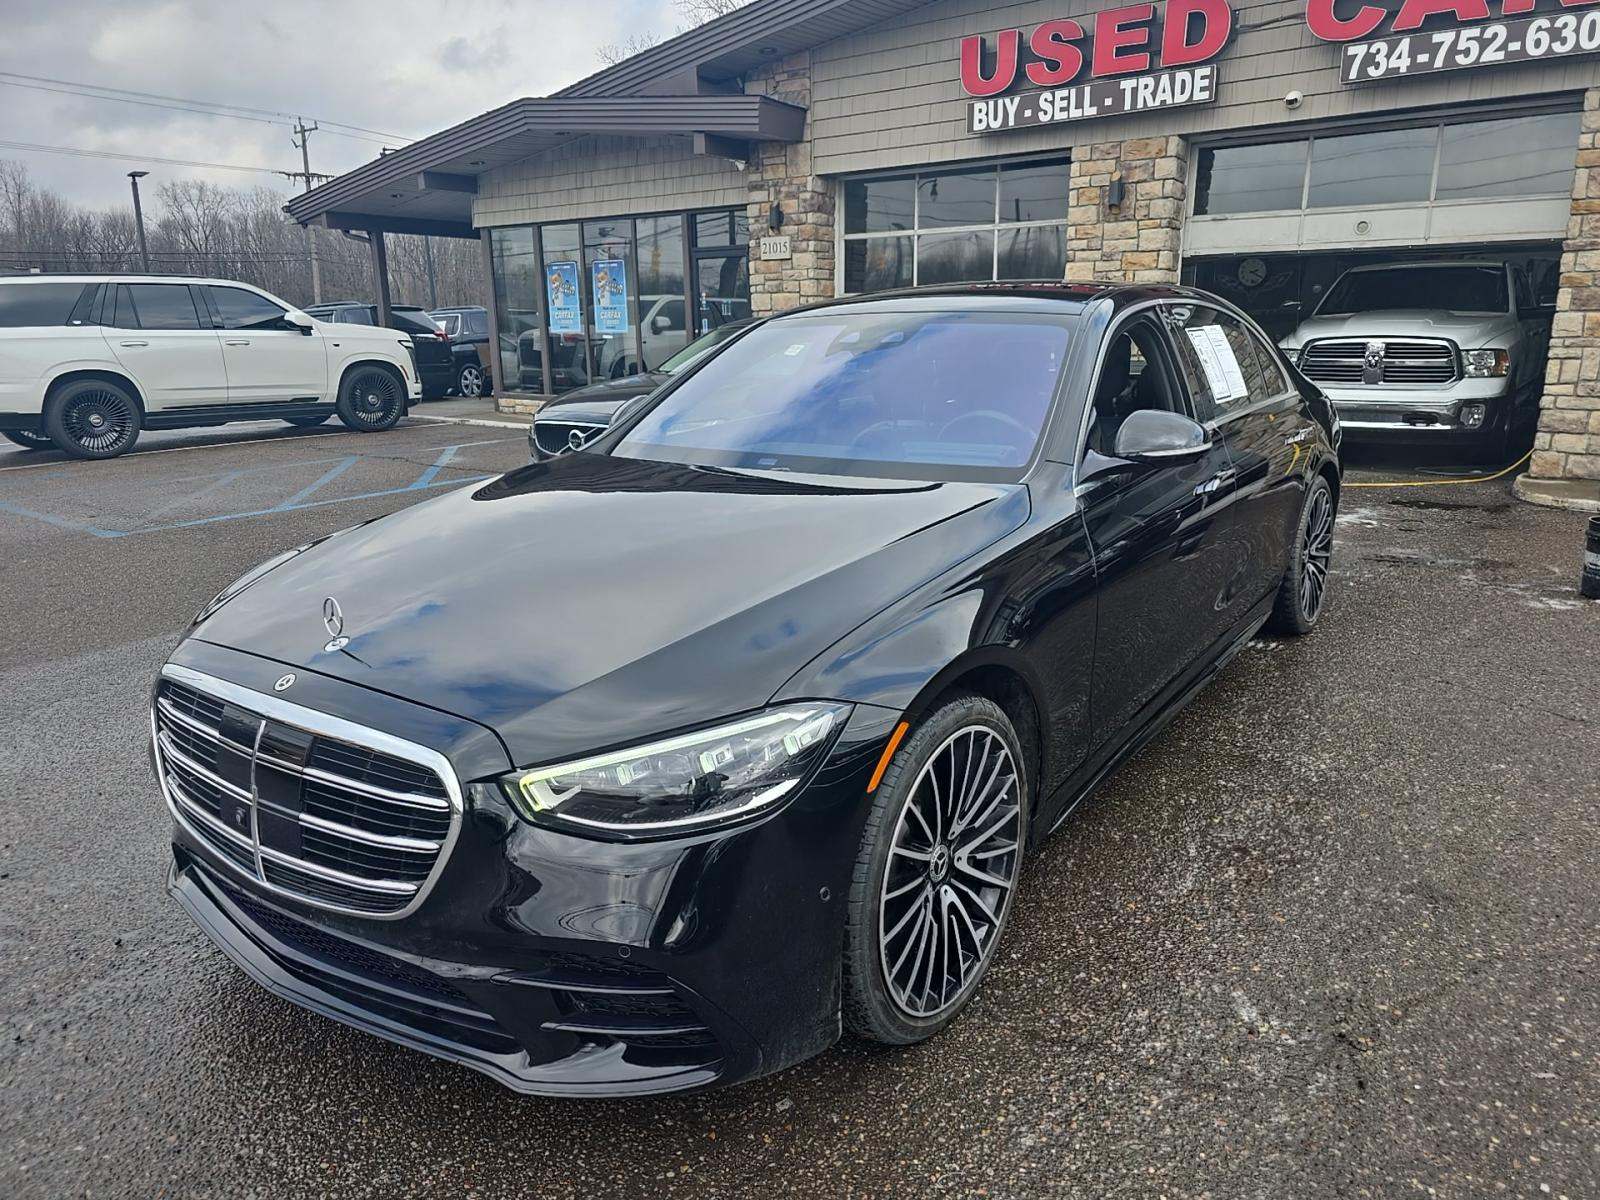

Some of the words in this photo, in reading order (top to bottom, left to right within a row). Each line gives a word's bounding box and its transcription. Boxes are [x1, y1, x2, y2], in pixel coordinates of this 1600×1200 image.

[960, 0, 1232, 97] USED
[1346, 11, 1600, 80] 734-752-630
[972, 98, 1021, 131] BUY
[1037, 86, 1098, 123] SELL
[1119, 67, 1211, 110] TRADE
[762, 241, 788, 255] 21015
